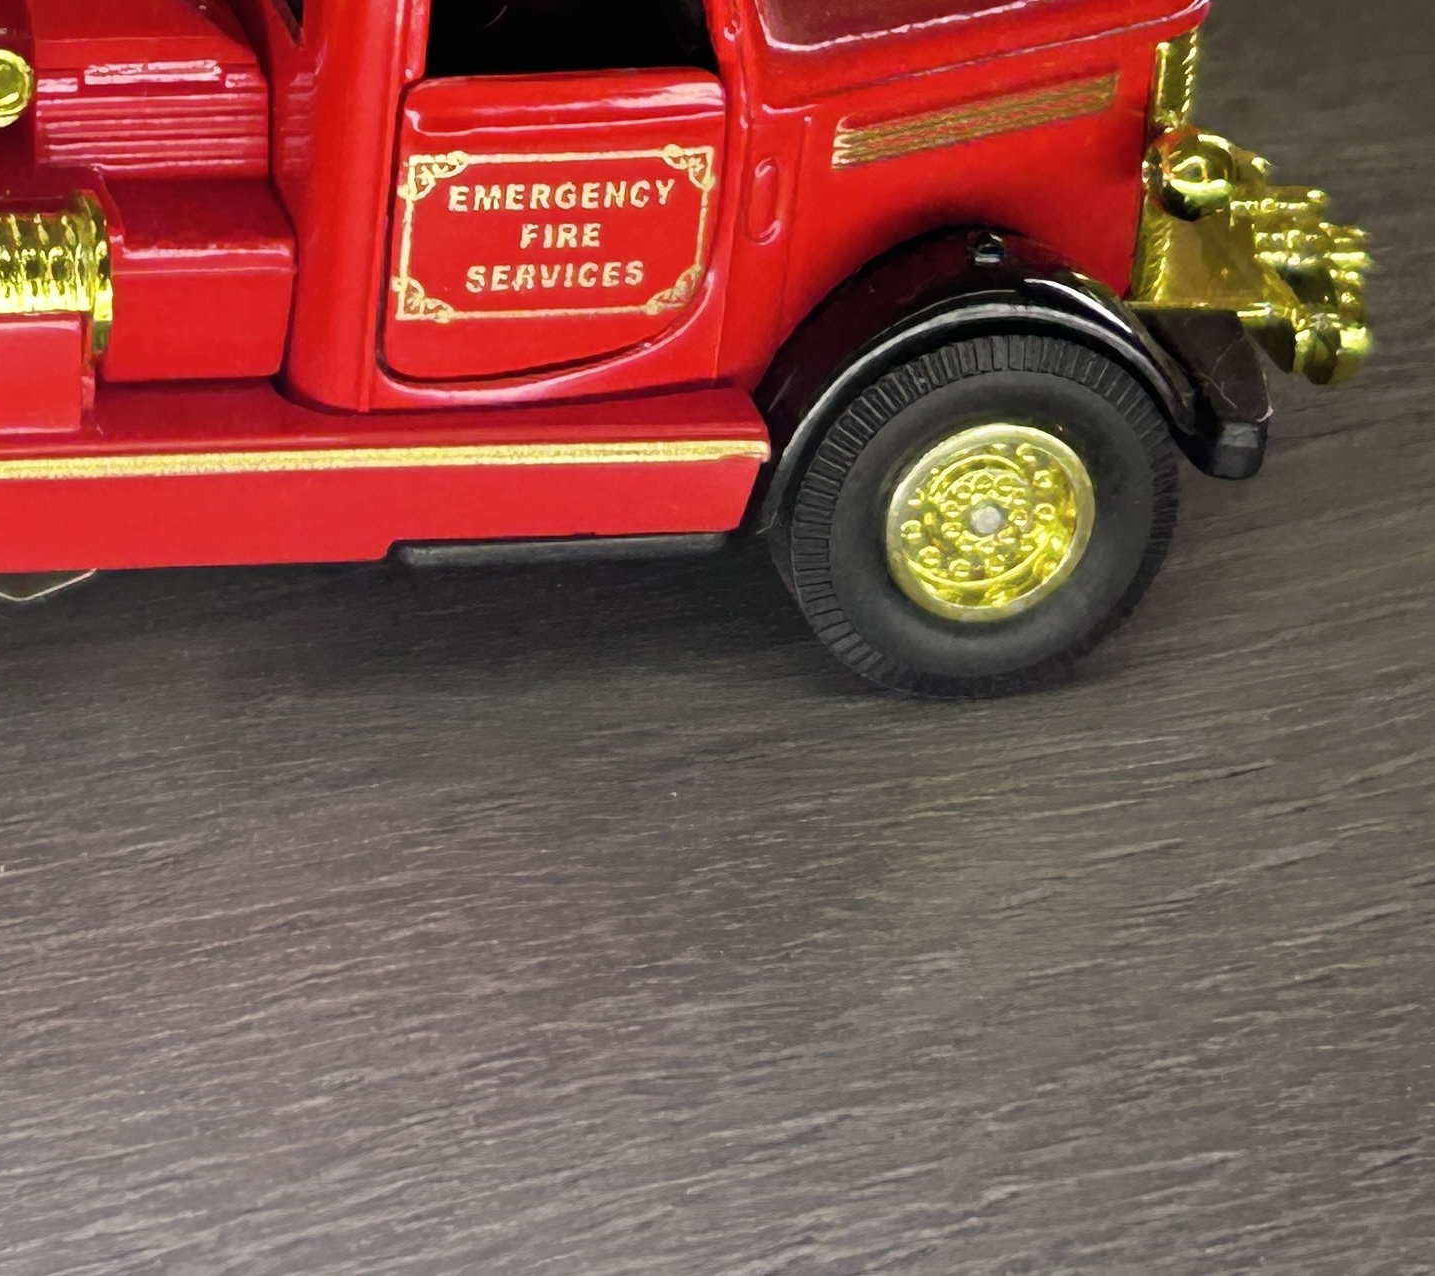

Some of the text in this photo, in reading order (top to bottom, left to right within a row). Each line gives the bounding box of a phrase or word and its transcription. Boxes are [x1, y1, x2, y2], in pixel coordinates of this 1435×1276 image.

[448, 179, 676, 212] EMERGENCY
[520, 223, 602, 249] FIRE
[465, 260, 645, 294] SERVICES
